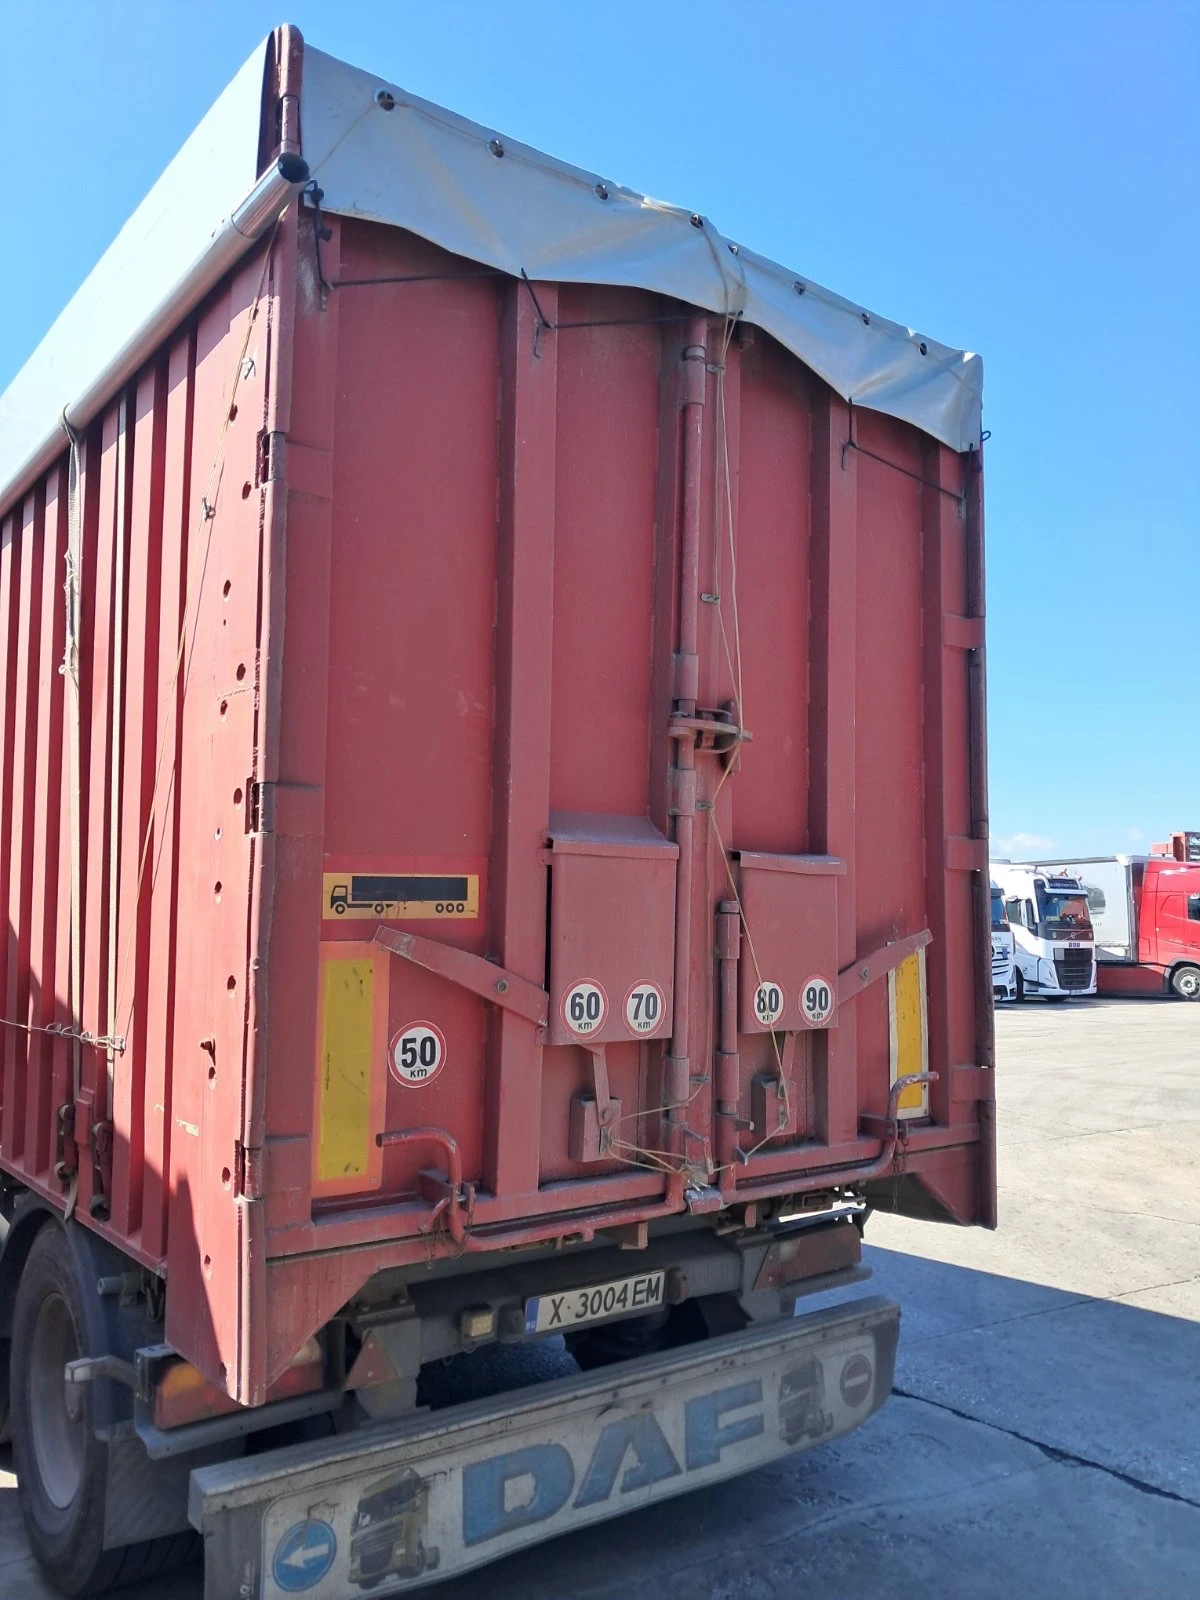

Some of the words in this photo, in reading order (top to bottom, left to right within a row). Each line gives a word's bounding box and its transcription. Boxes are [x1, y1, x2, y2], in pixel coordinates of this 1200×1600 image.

[569, 990, 601, 1021] 60
[630, 991, 657, 1020] 70
[756, 987, 780, 1014] 80
[805, 986, 829, 1012] 90
[400, 1035, 437, 1069] 50
[462, 1378, 766, 1548] DAF
